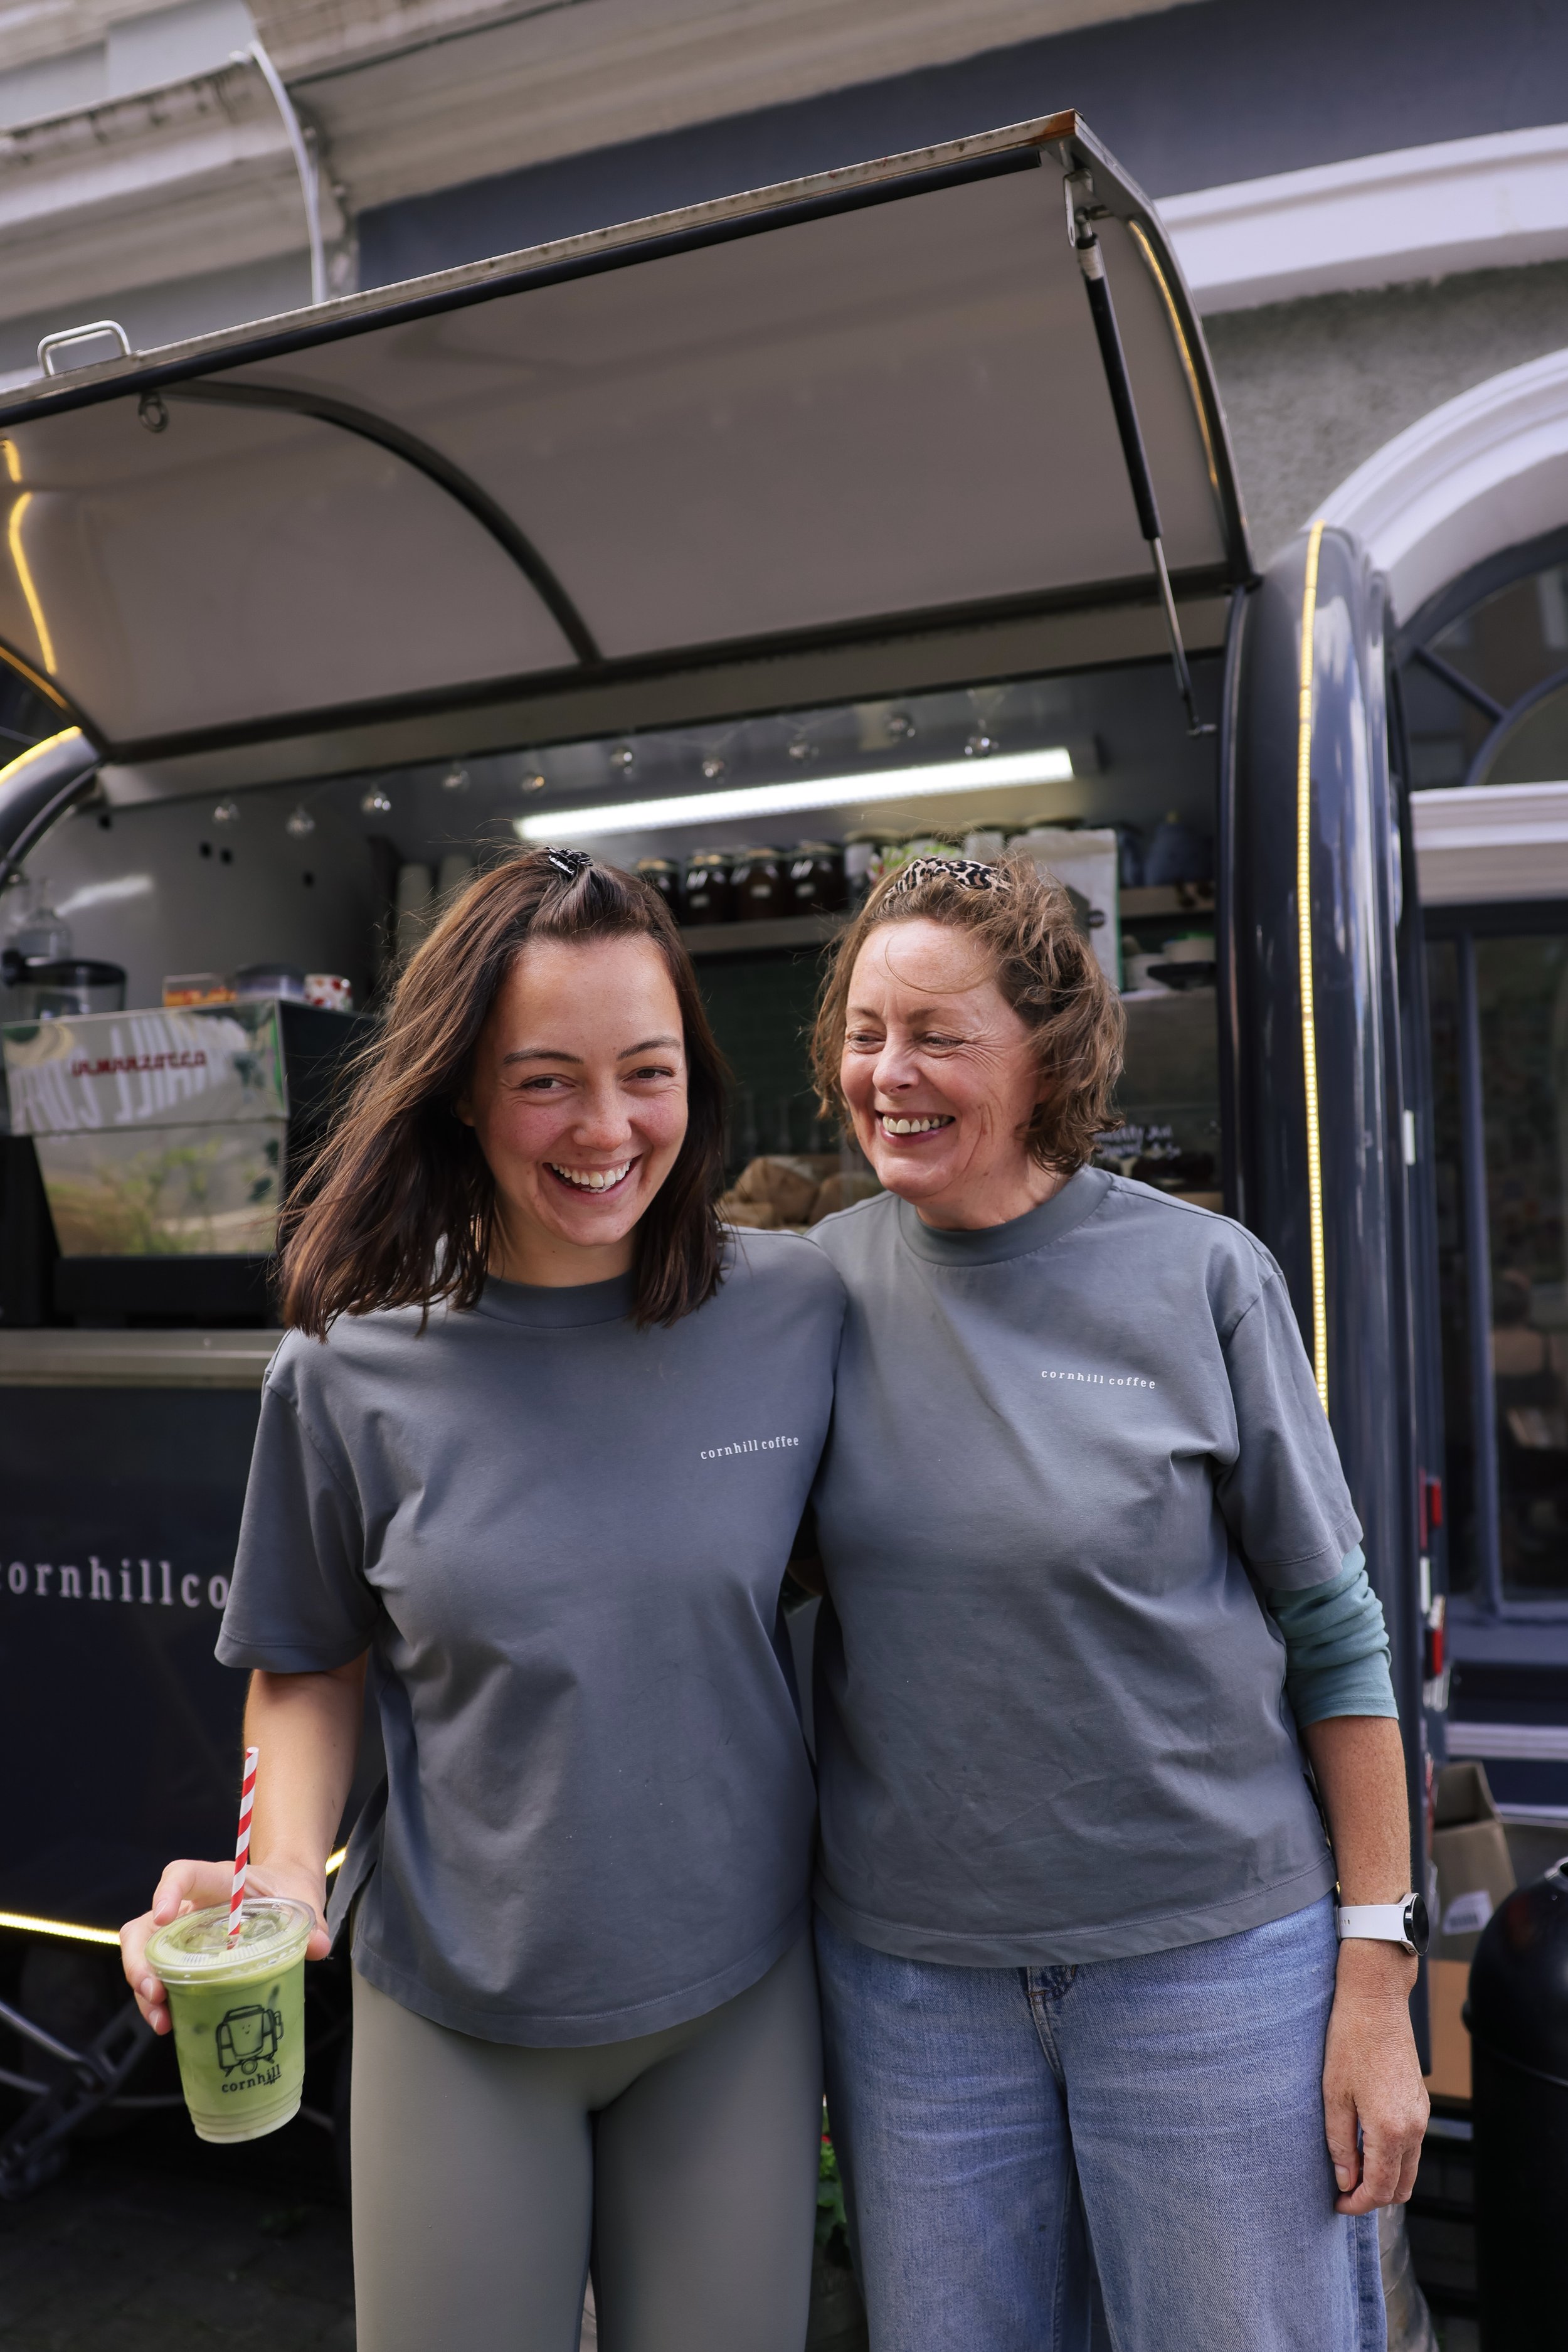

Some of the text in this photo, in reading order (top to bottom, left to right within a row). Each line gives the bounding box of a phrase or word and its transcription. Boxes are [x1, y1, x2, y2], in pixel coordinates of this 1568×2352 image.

[1041, 1370, 1156, 1389] cornhill coffee
[700, 1435, 800, 1460] cornhill coffee
[0, 1556, 230, 1610] ornhillco
[221, 2063, 282, 2093] cornhill
